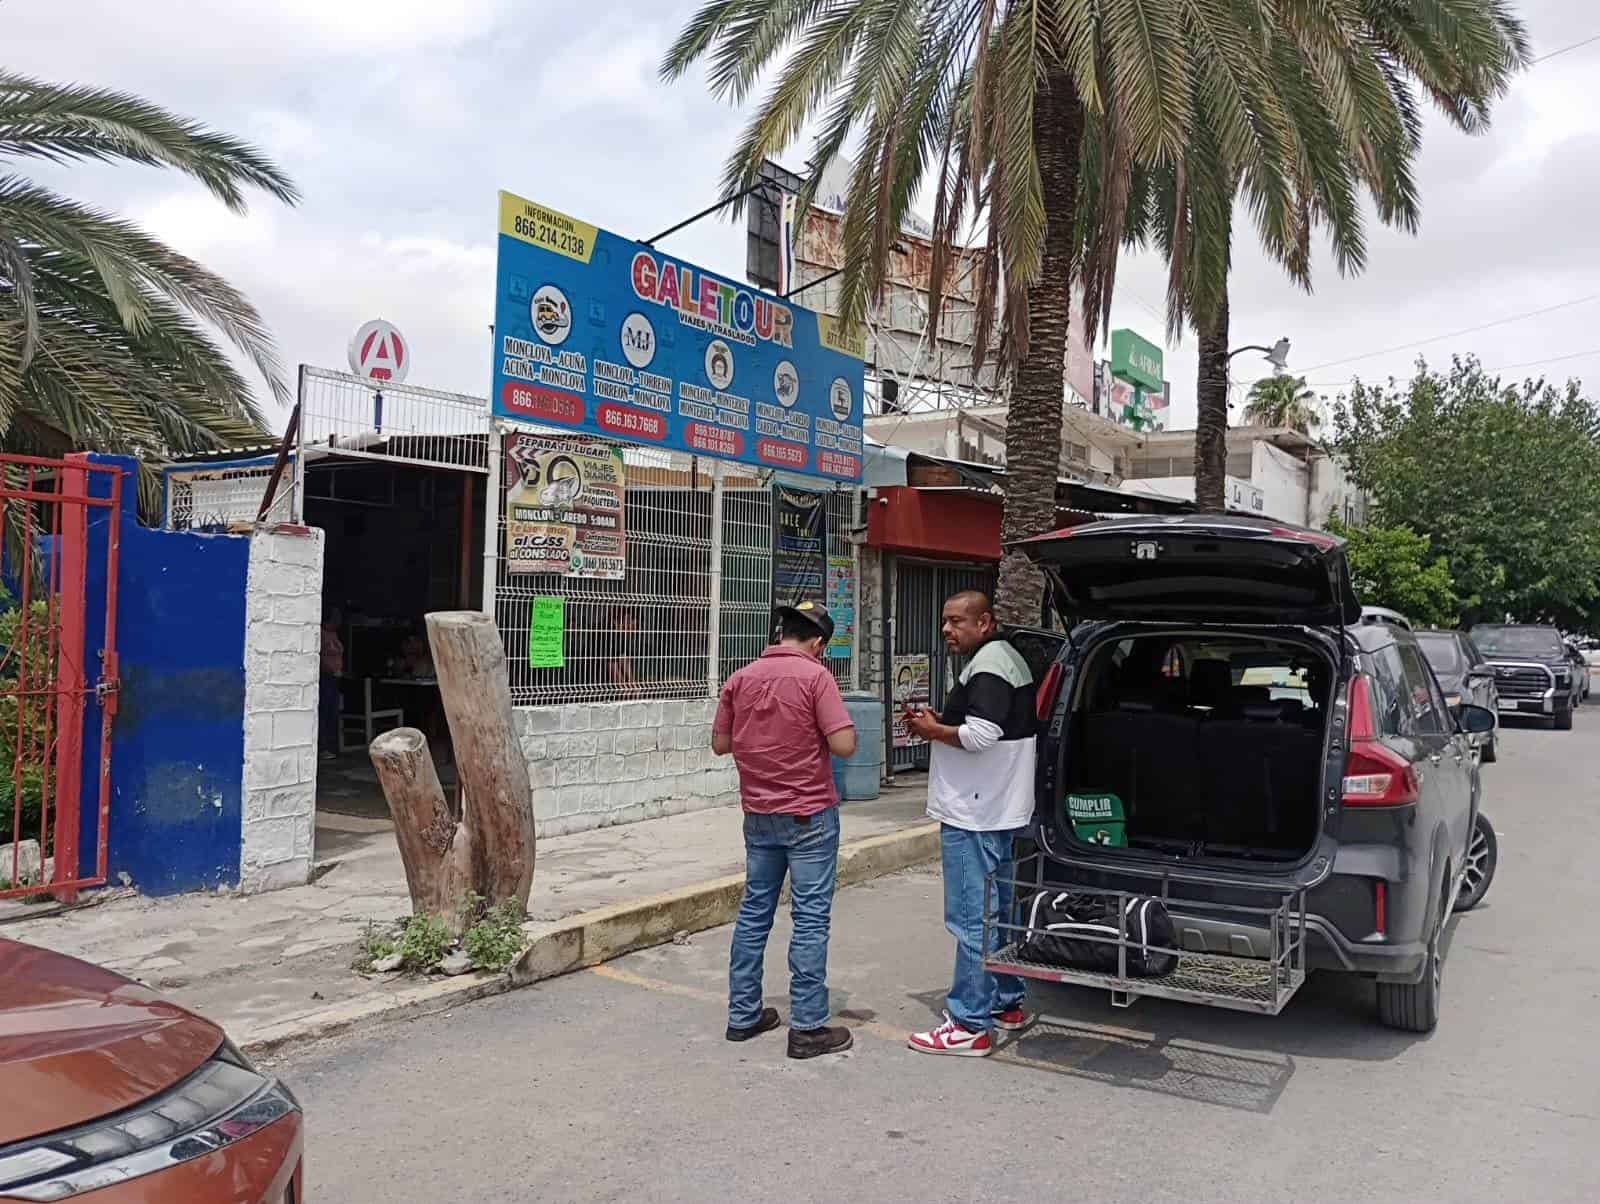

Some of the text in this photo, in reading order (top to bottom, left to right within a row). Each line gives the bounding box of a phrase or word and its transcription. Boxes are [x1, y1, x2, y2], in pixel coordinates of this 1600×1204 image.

[515, 216, 584, 256] 866.214.2138
[632, 252, 793, 348] GALETOUR
[680, 312, 706, 330] VIAJES
[714, 324, 756, 346] TRASLADOS
[519, 436, 559, 450] SEPARA
